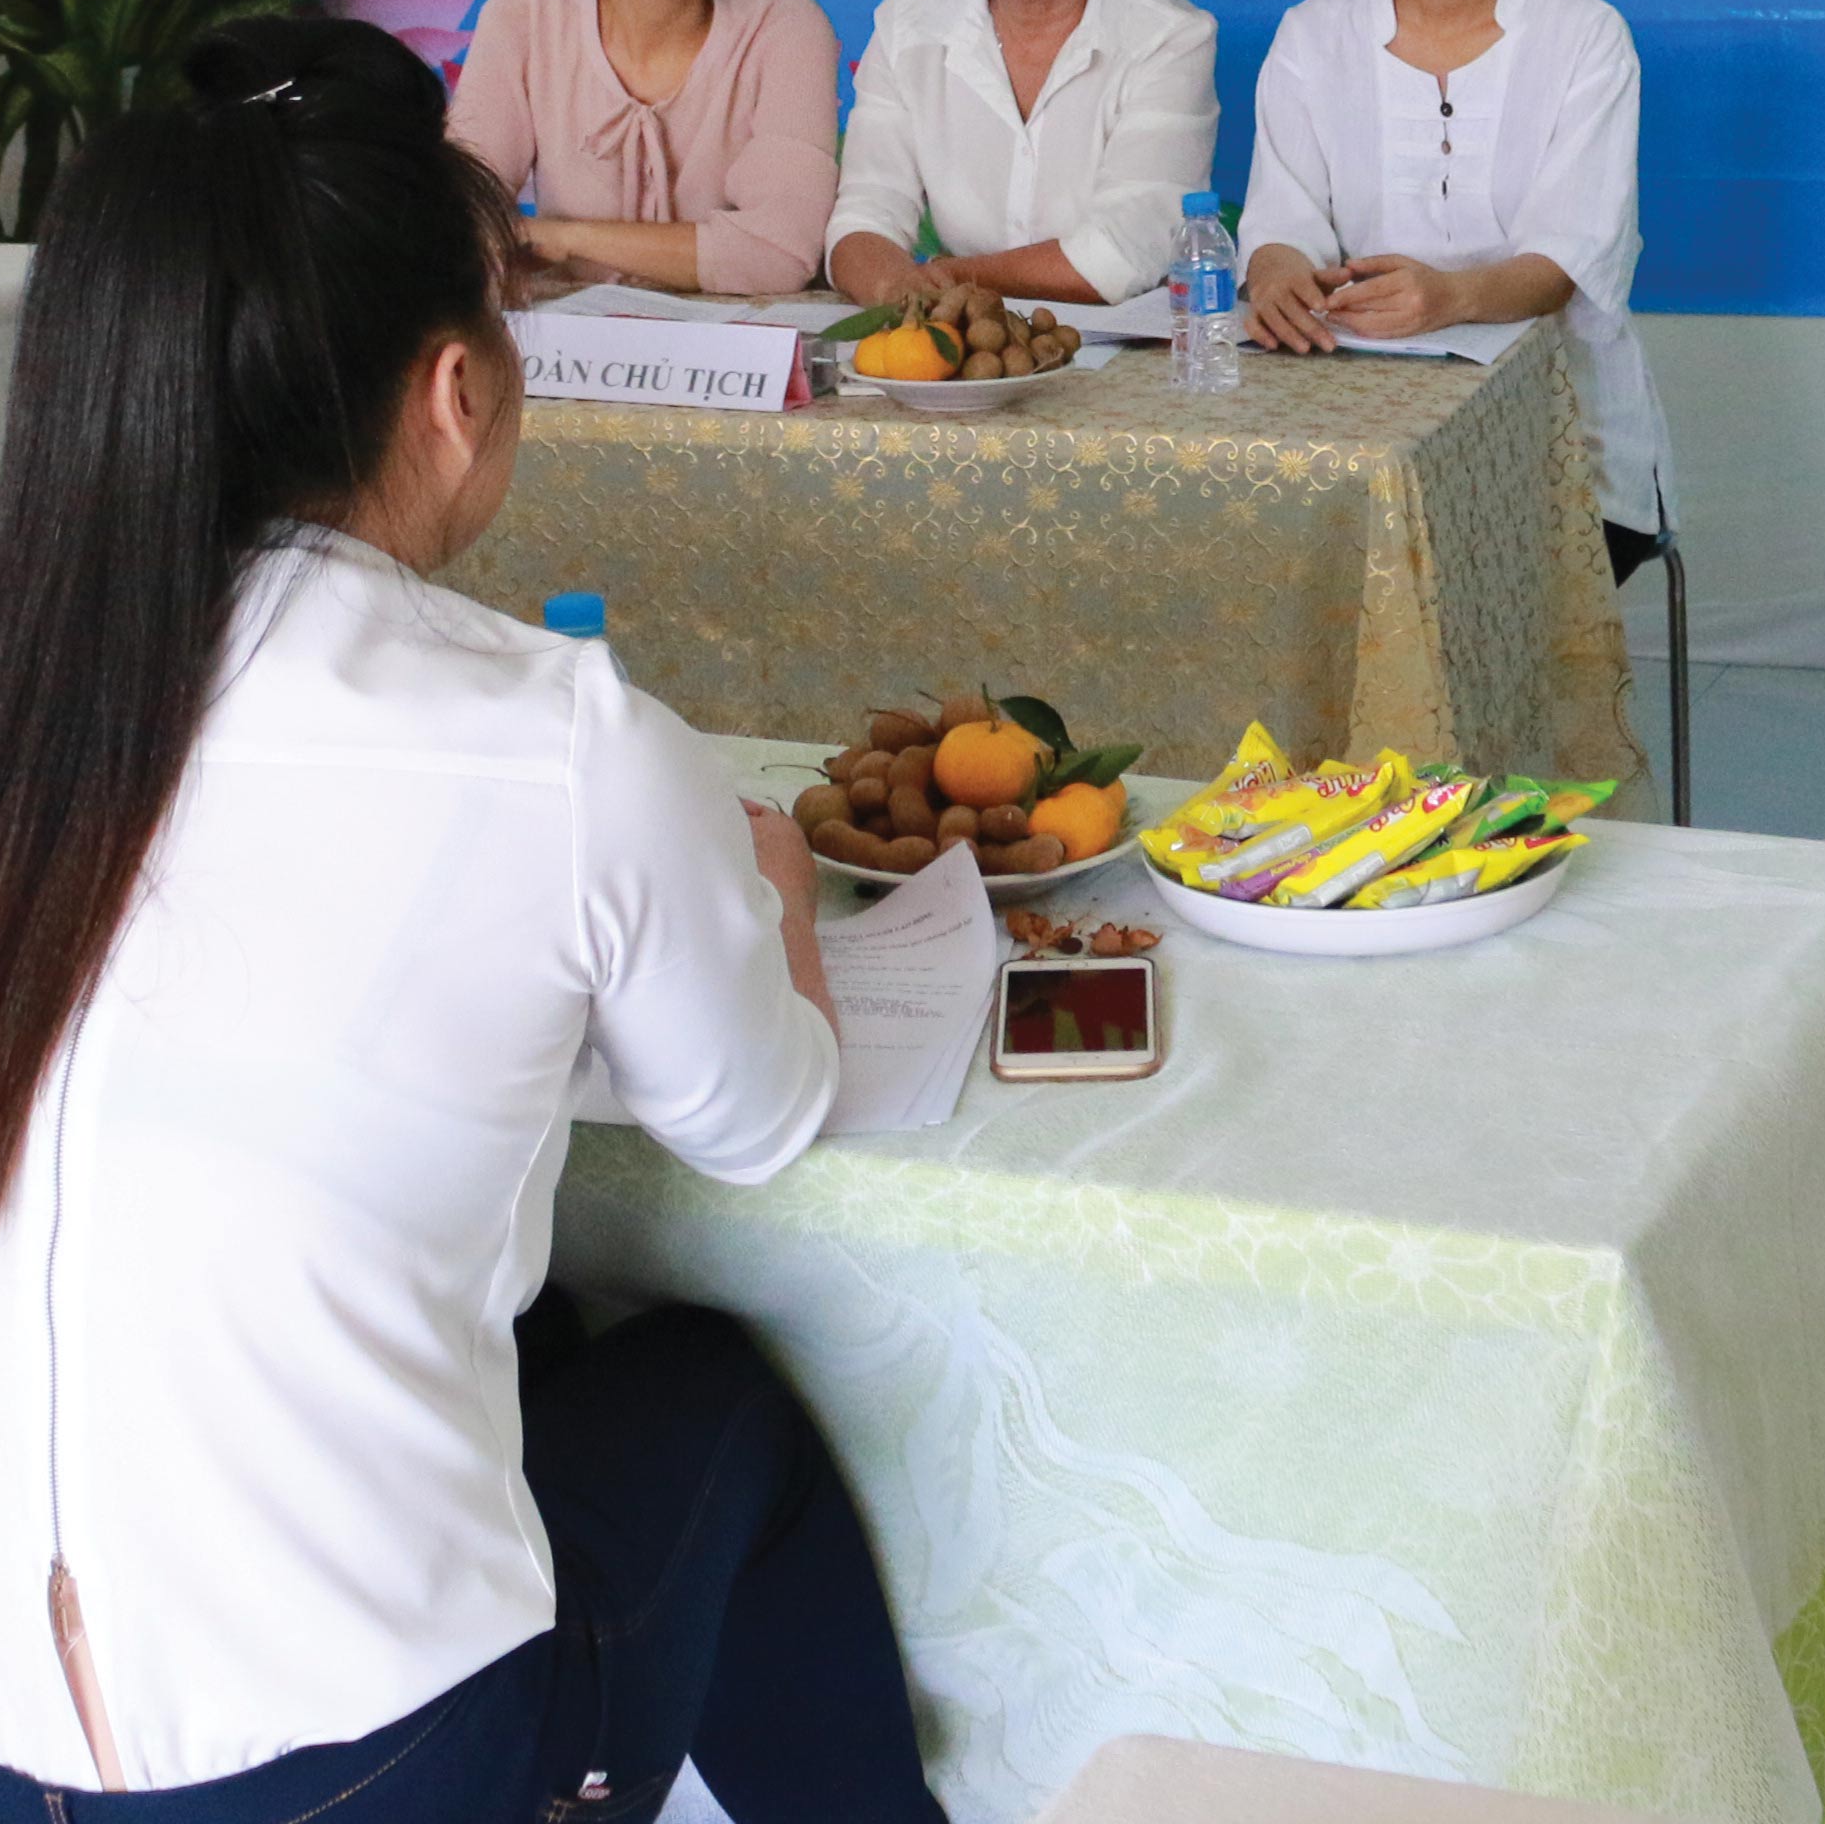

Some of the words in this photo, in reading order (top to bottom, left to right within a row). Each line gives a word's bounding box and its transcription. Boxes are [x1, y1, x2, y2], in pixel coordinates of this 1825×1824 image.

[523, 349, 592, 385] OÀN
[600, 356, 674, 392] CHỦ
[684, 367, 768, 401] TỊCH
